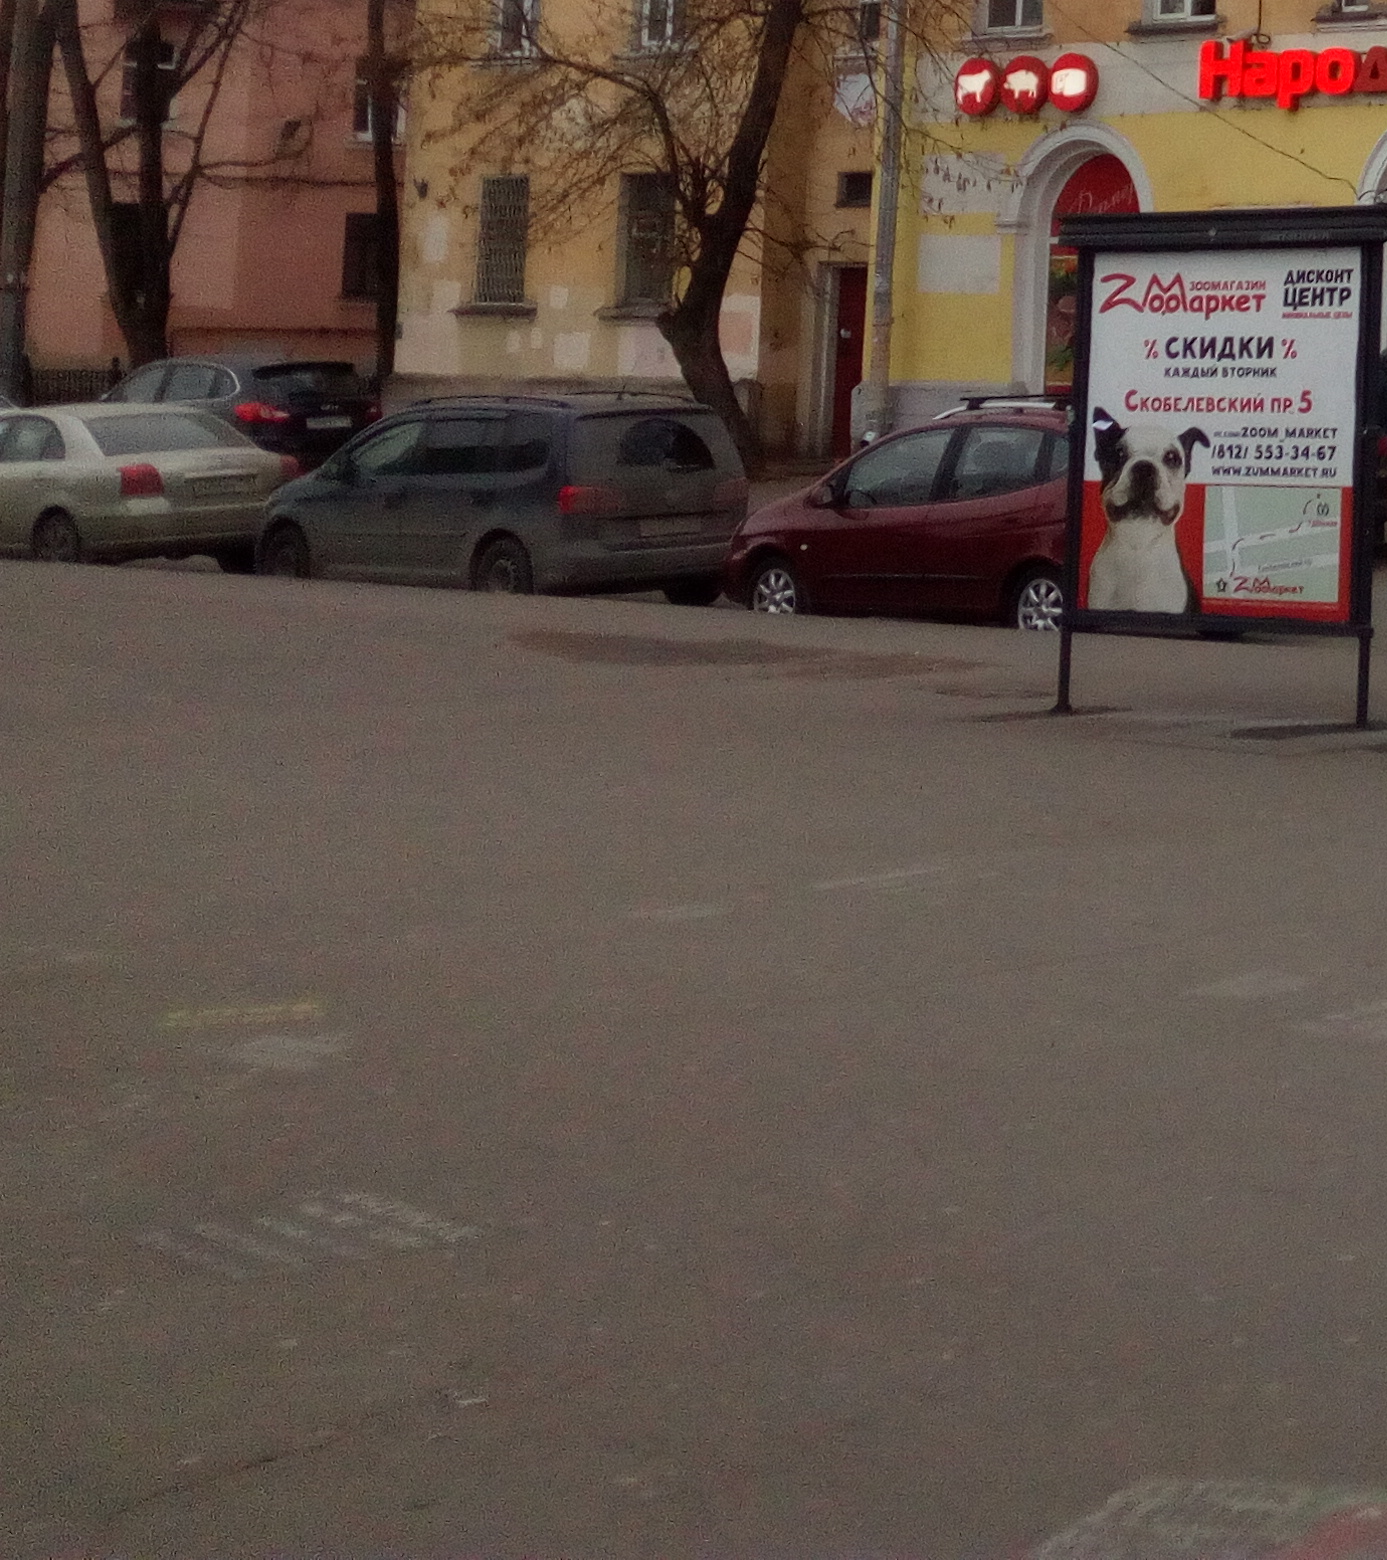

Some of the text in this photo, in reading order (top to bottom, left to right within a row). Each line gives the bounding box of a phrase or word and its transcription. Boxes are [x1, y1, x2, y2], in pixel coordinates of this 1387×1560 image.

[1189, 280, 1267, 292] ЗООМАГАЗИН
[1283, 268, 1354, 287] ДИСКОНТ
[1283, 286, 1352, 311] ЦЕНТР
[1164, 335, 1275, 362] СКИДКИ
[1163, 364, 1278, 379] КАЖДЫЙ ВТОРНИК
[1297, 389, 1313, 414] 5
[1254, 444, 1337, 461] 553-34-67
